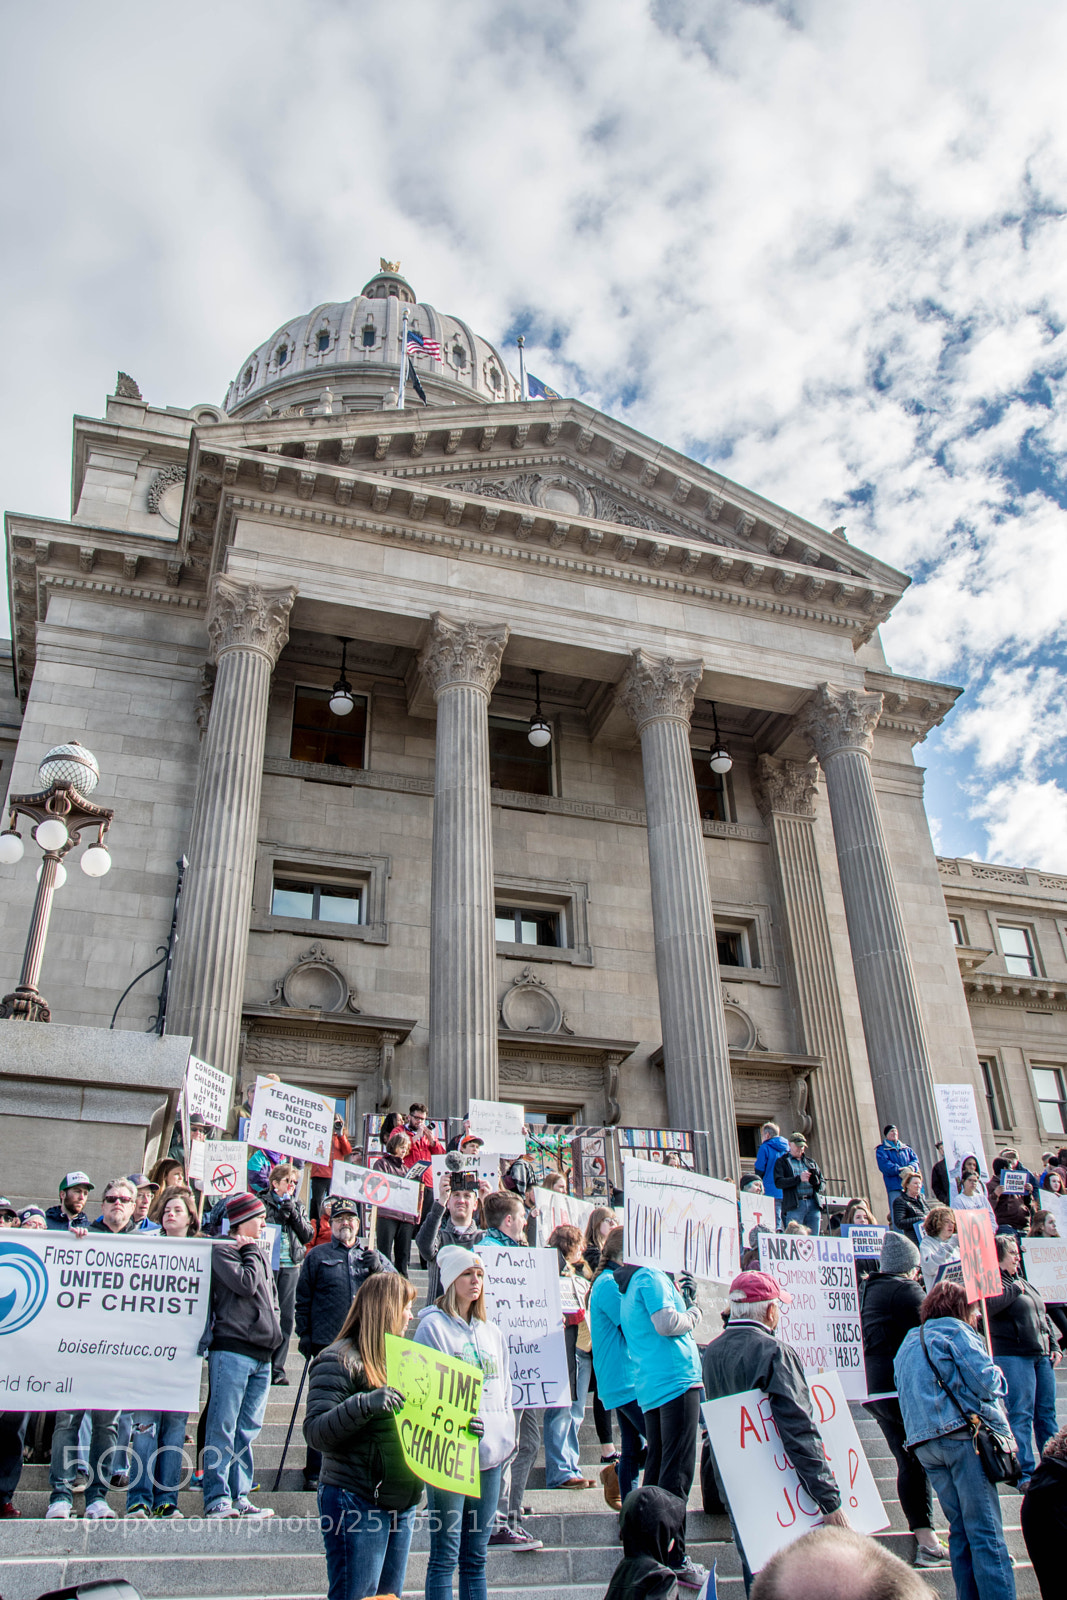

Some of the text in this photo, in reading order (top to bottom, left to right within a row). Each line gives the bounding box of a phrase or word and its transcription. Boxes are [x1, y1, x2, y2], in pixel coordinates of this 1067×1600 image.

[194, 1074, 226, 1096] CHILDRENS
[200, 1086, 218, 1102] LIVES
[193, 1092, 222, 1113] NOT NRA
[270, 1088, 324, 1112] TEACHERS
[285, 1104, 312, 1118] NEED
[265, 1108, 328, 1134] RESOURCES
[285, 1126, 307, 1138] NOT
[278, 1135, 310, 1150] GUNS!
[465, 1157, 480, 1166] RM
[960, 1214, 988, 1251] NOT
[44, 1246, 203, 1272] FIRST CONGREGATIONAL
[496, 1252, 536, 1268] March
[768, 1238, 800, 1260] NRA
[817, 1240, 853, 1263] Idaho
[777, 1262, 816, 1287] SIMPSON
[962, 1248, 984, 1281] ONE
[60, 1270, 200, 1294] UNITED CHURCH
[488, 1275, 527, 1286] because
[973, 1267, 1000, 1297] MORE
[57, 1292, 198, 1315] OF CHRIST
[516, 1289, 548, 1308] tired
[508, 1316, 548, 1337] watching
[781, 1316, 816, 1342] RISCH
[58, 1339, 177, 1360] boisefirstucc.org
[508, 1334, 541, 1354] future
[26, 1376, 51, 1392] for
[56, 1377, 73, 1393] all
[435, 1362, 481, 1414] TIME
[512, 1382, 558, 1406] DIE
[432, 1405, 466, 1438] for
[740, 1385, 836, 1449] ARD
